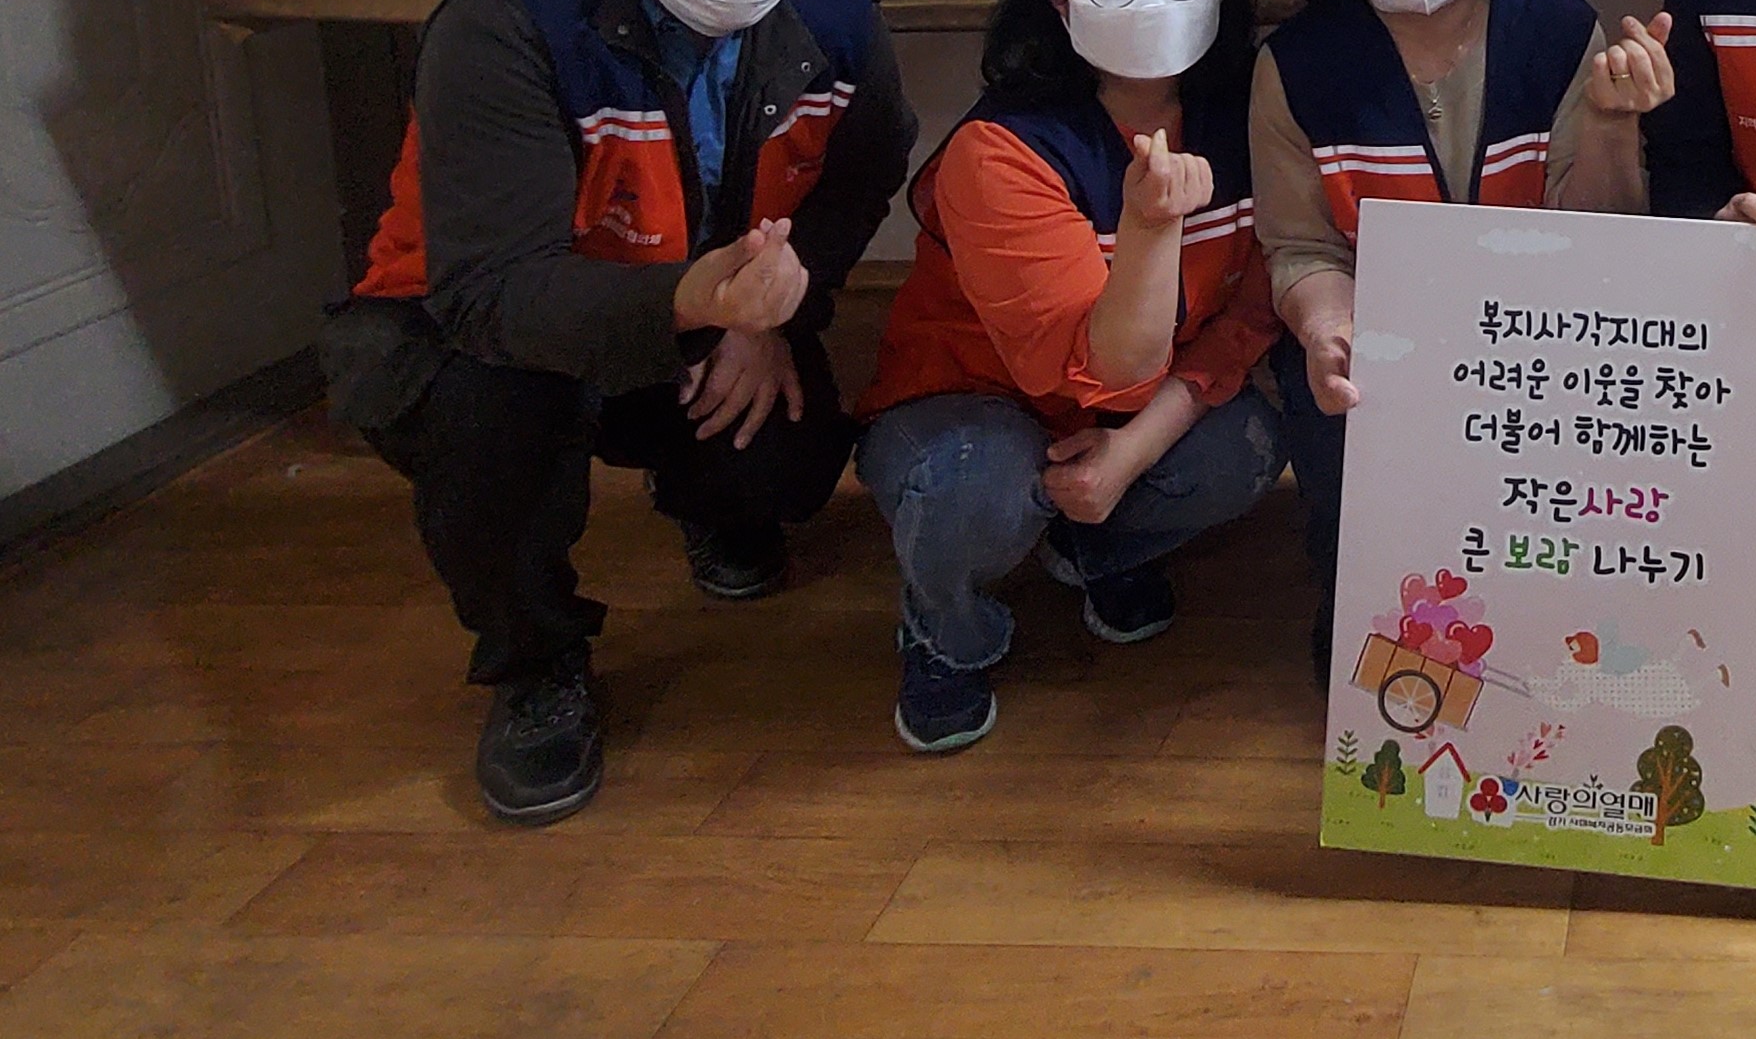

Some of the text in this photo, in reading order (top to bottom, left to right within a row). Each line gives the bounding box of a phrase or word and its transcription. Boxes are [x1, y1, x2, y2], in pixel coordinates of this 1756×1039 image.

[1479, 300, 1707, 350] 복지사각지대의
[1453, 358, 1731, 410] 어려운 이웃을 찾아
[1465, 408, 1712, 467] 더불어 함께하는
[1462, 527, 1704, 583] 큰 보람 나누기
[1515, 784, 1654, 818] 사랑의열매
